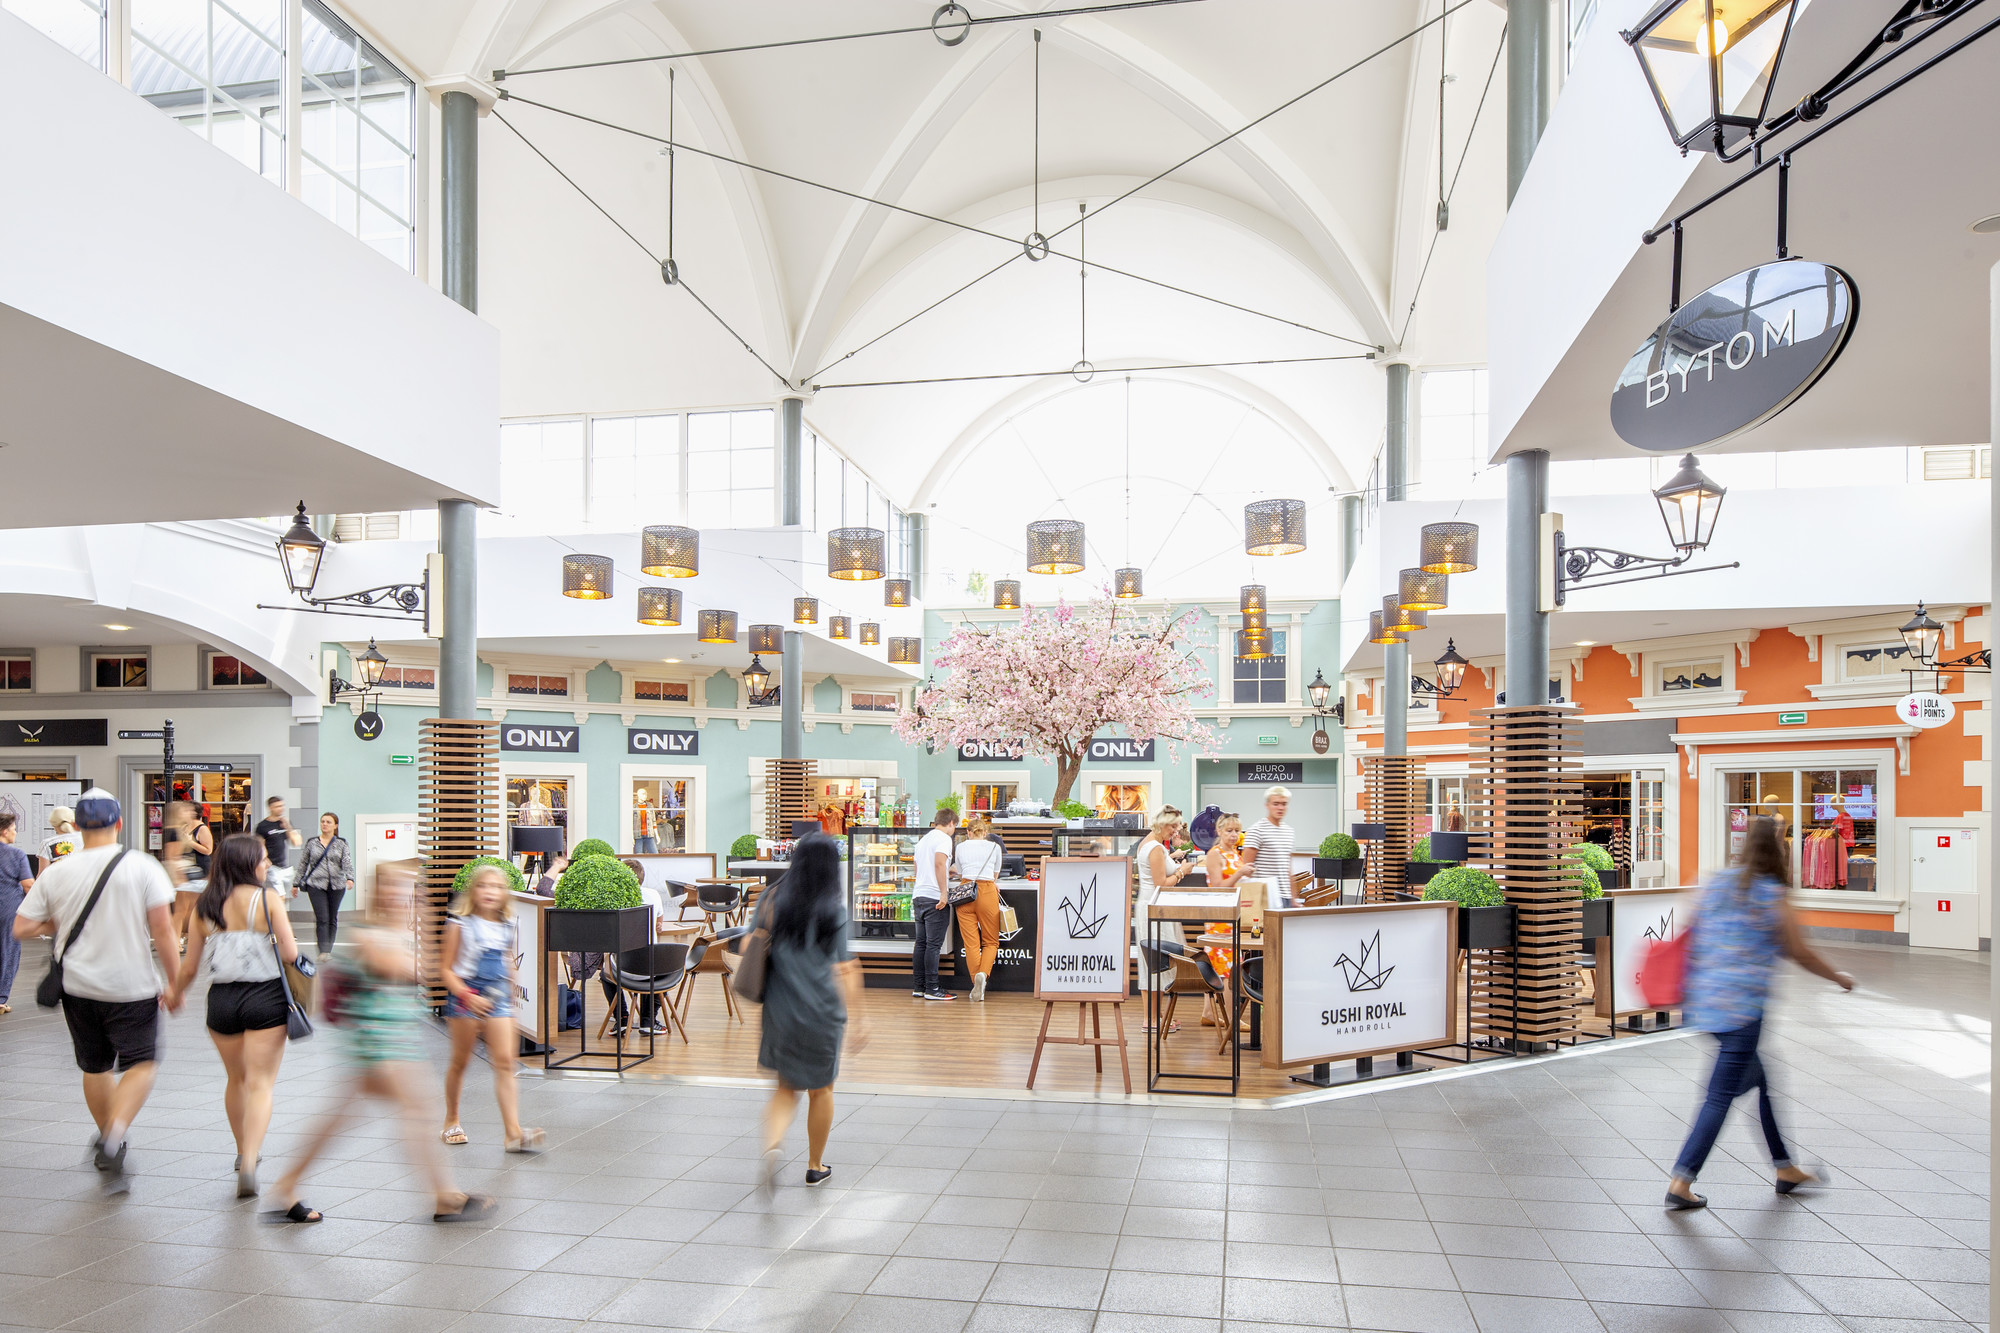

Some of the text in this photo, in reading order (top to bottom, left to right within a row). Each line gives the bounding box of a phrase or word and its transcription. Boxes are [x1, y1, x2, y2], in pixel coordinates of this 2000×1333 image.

[1646, 309, 1795, 408] BYTOM
[1924, 699, 1939, 708] LOLA
[1924, 708, 1945, 718] POINTS
[506, 728, 574, 748] ONLY
[633, 733, 694, 751] ONLY
[1091, 742, 1150, 757] ONLY
[1255, 764, 1285, 772] BIURO
[1247, 773, 1294, 782] ZARZĄDU
[997, 948, 1033, 959] ROYAL
[1046, 954, 1116, 971] SUSHI ROYAL
[1057, 975, 1103, 984] HANDROLL
[513, 984, 529, 1002] OYAL
[1321, 1001, 1406, 1026] SUSHI ROYAL
[1336, 1022, 1391, 1035] HANDROLL
